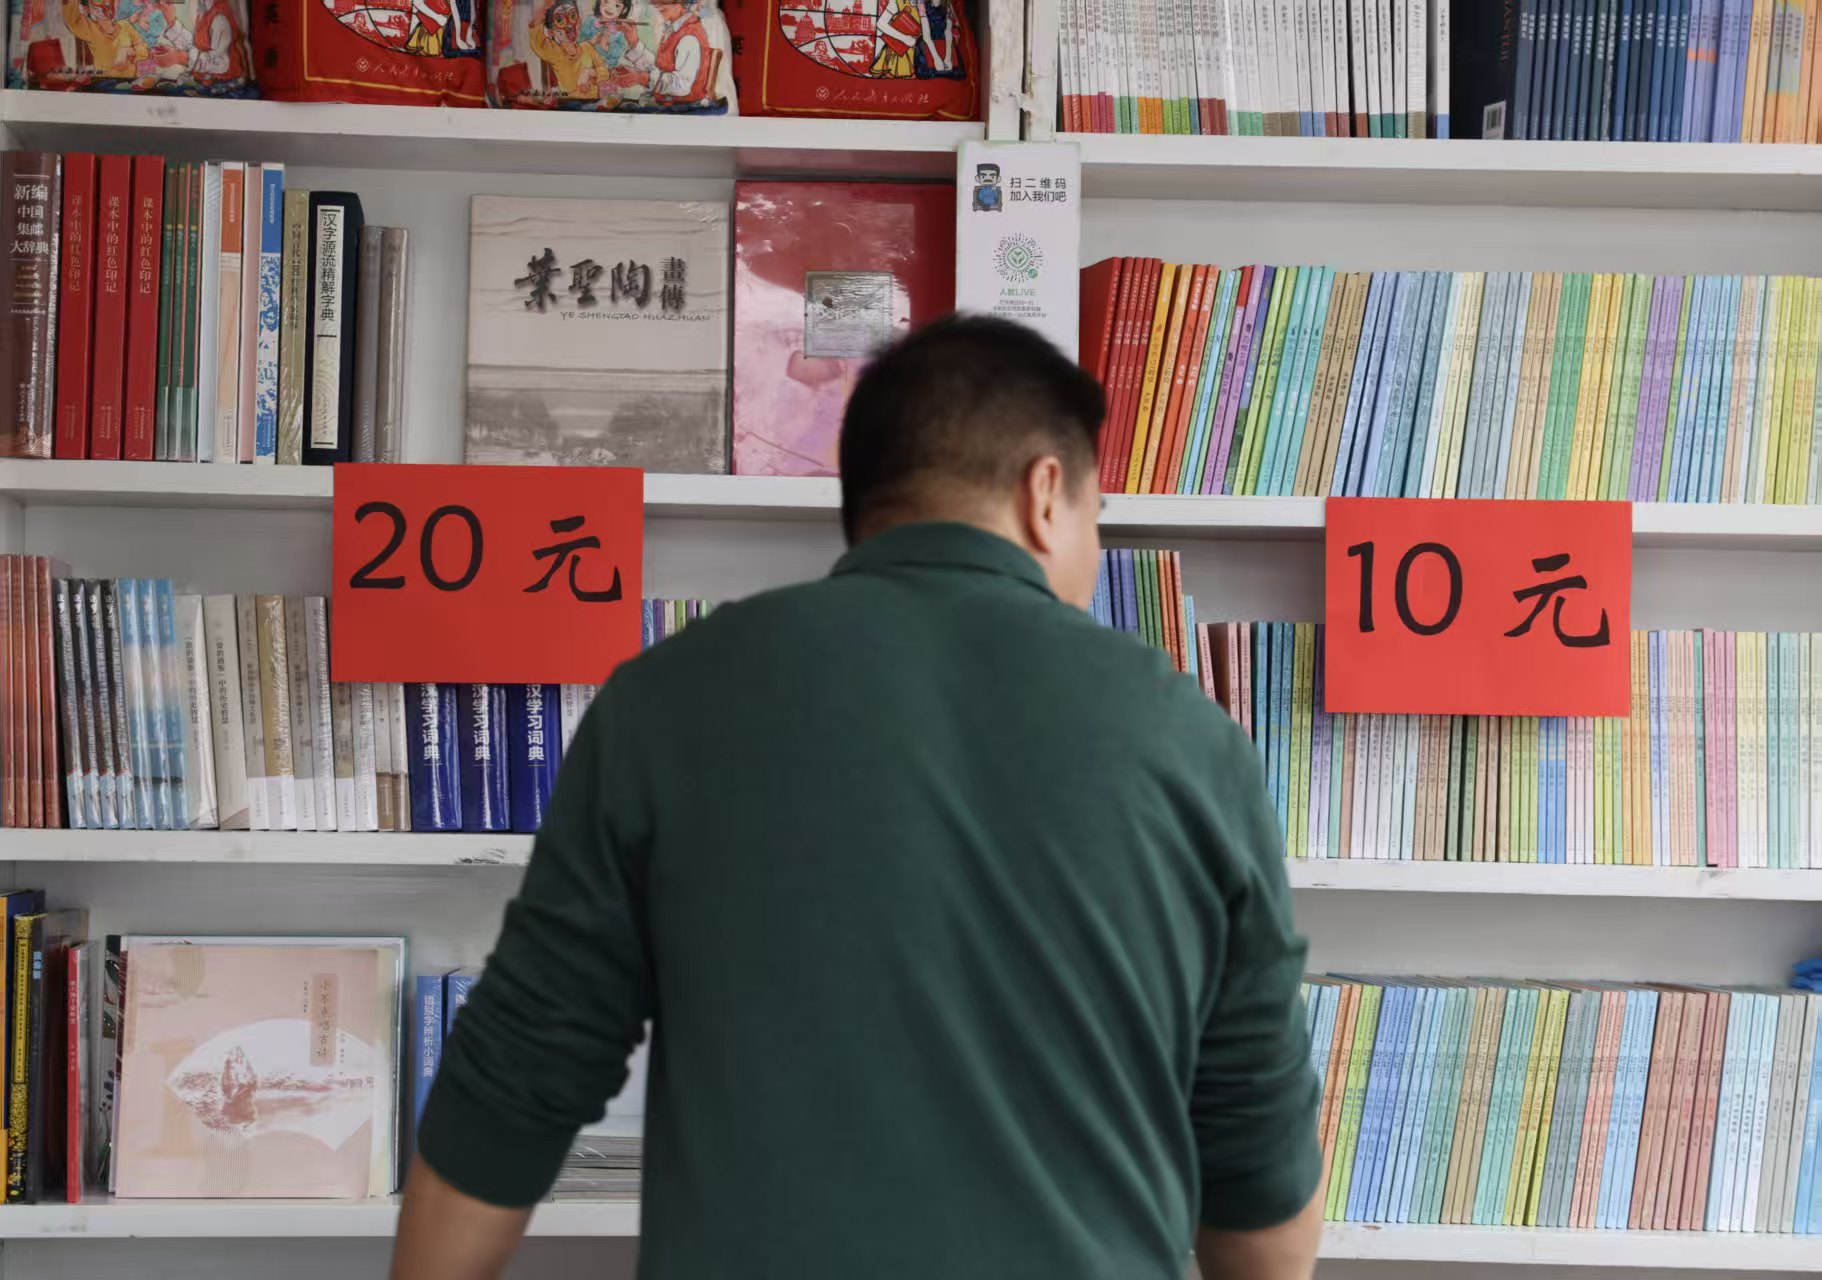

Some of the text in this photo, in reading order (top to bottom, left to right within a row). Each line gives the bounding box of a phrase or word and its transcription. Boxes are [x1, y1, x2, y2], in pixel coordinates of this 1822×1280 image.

[1010, 177, 1067, 189] 扫二维码
[15, 184, 49, 201] 新编
[1010, 190, 1067, 203] 加入我们吧
[18, 205, 44, 219] 中国
[10, 241, 50, 255] 大辞典
[105, 196, 121, 294] 课本中的红色印记
[140, 197, 154, 295] 课本中的红色印记
[320, 213, 338, 322] 汉字源流精解字典
[560, 311, 575, 321] YE
[349, 501, 623, 603] 20 元
[1347, 541, 1610, 648] 10 元
